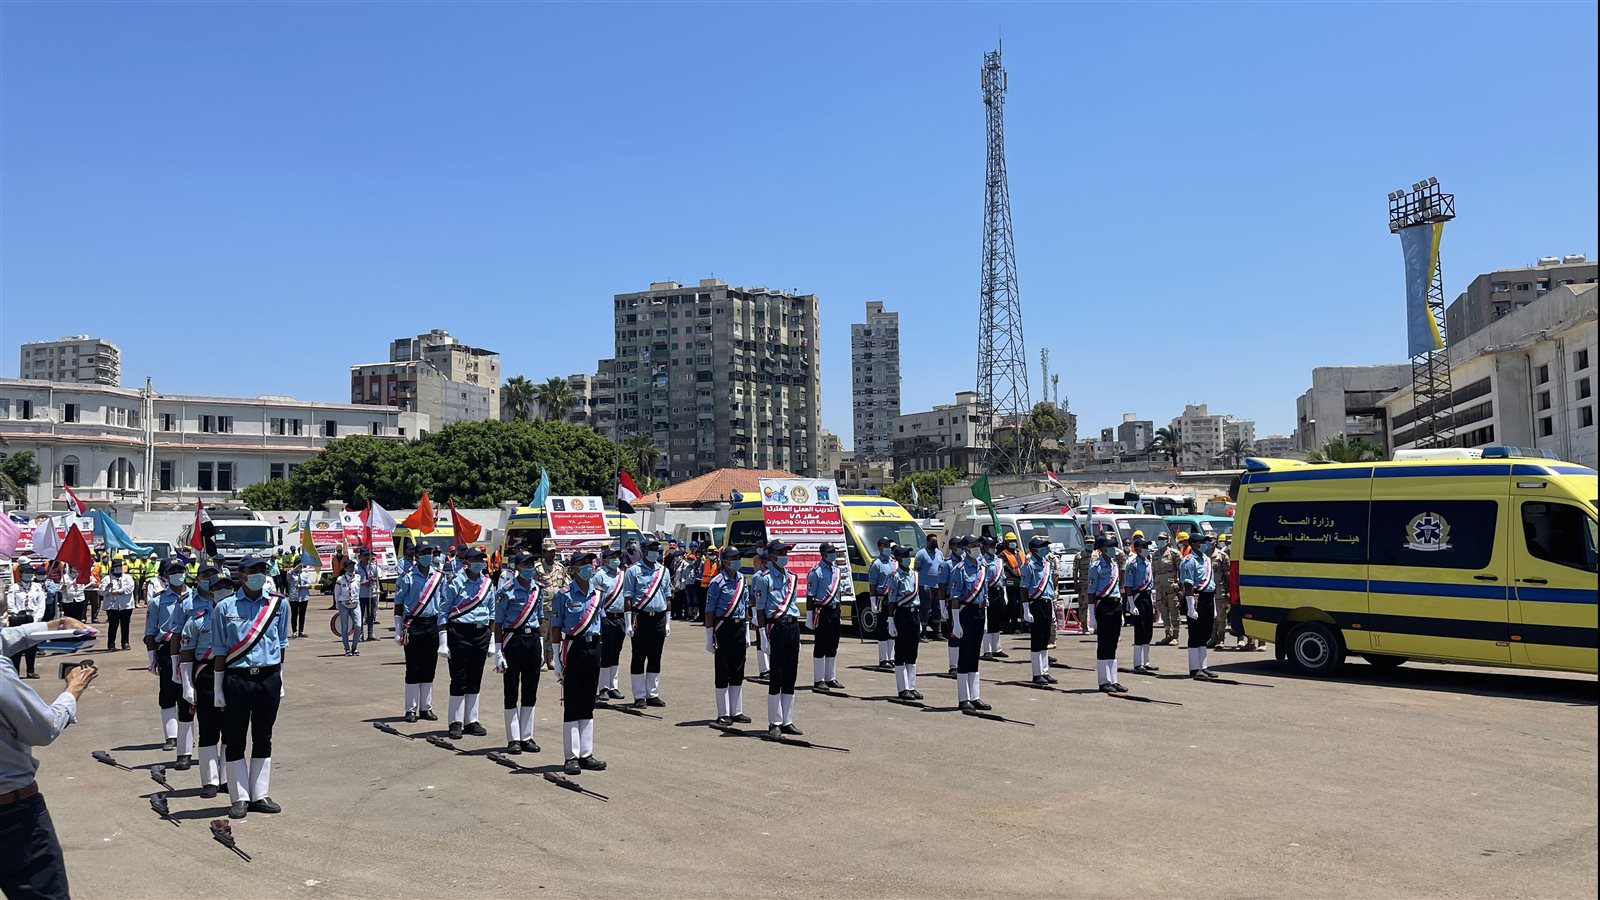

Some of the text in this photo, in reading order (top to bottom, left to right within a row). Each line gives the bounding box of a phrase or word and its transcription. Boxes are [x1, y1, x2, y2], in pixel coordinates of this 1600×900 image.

[766, 505, 793, 513] المشترك
[1278, 515, 1335, 527] وزارة الصحة
[1253, 531, 1293, 542] المصرية
[1295, 532, 1332, 544] الإسعاف
